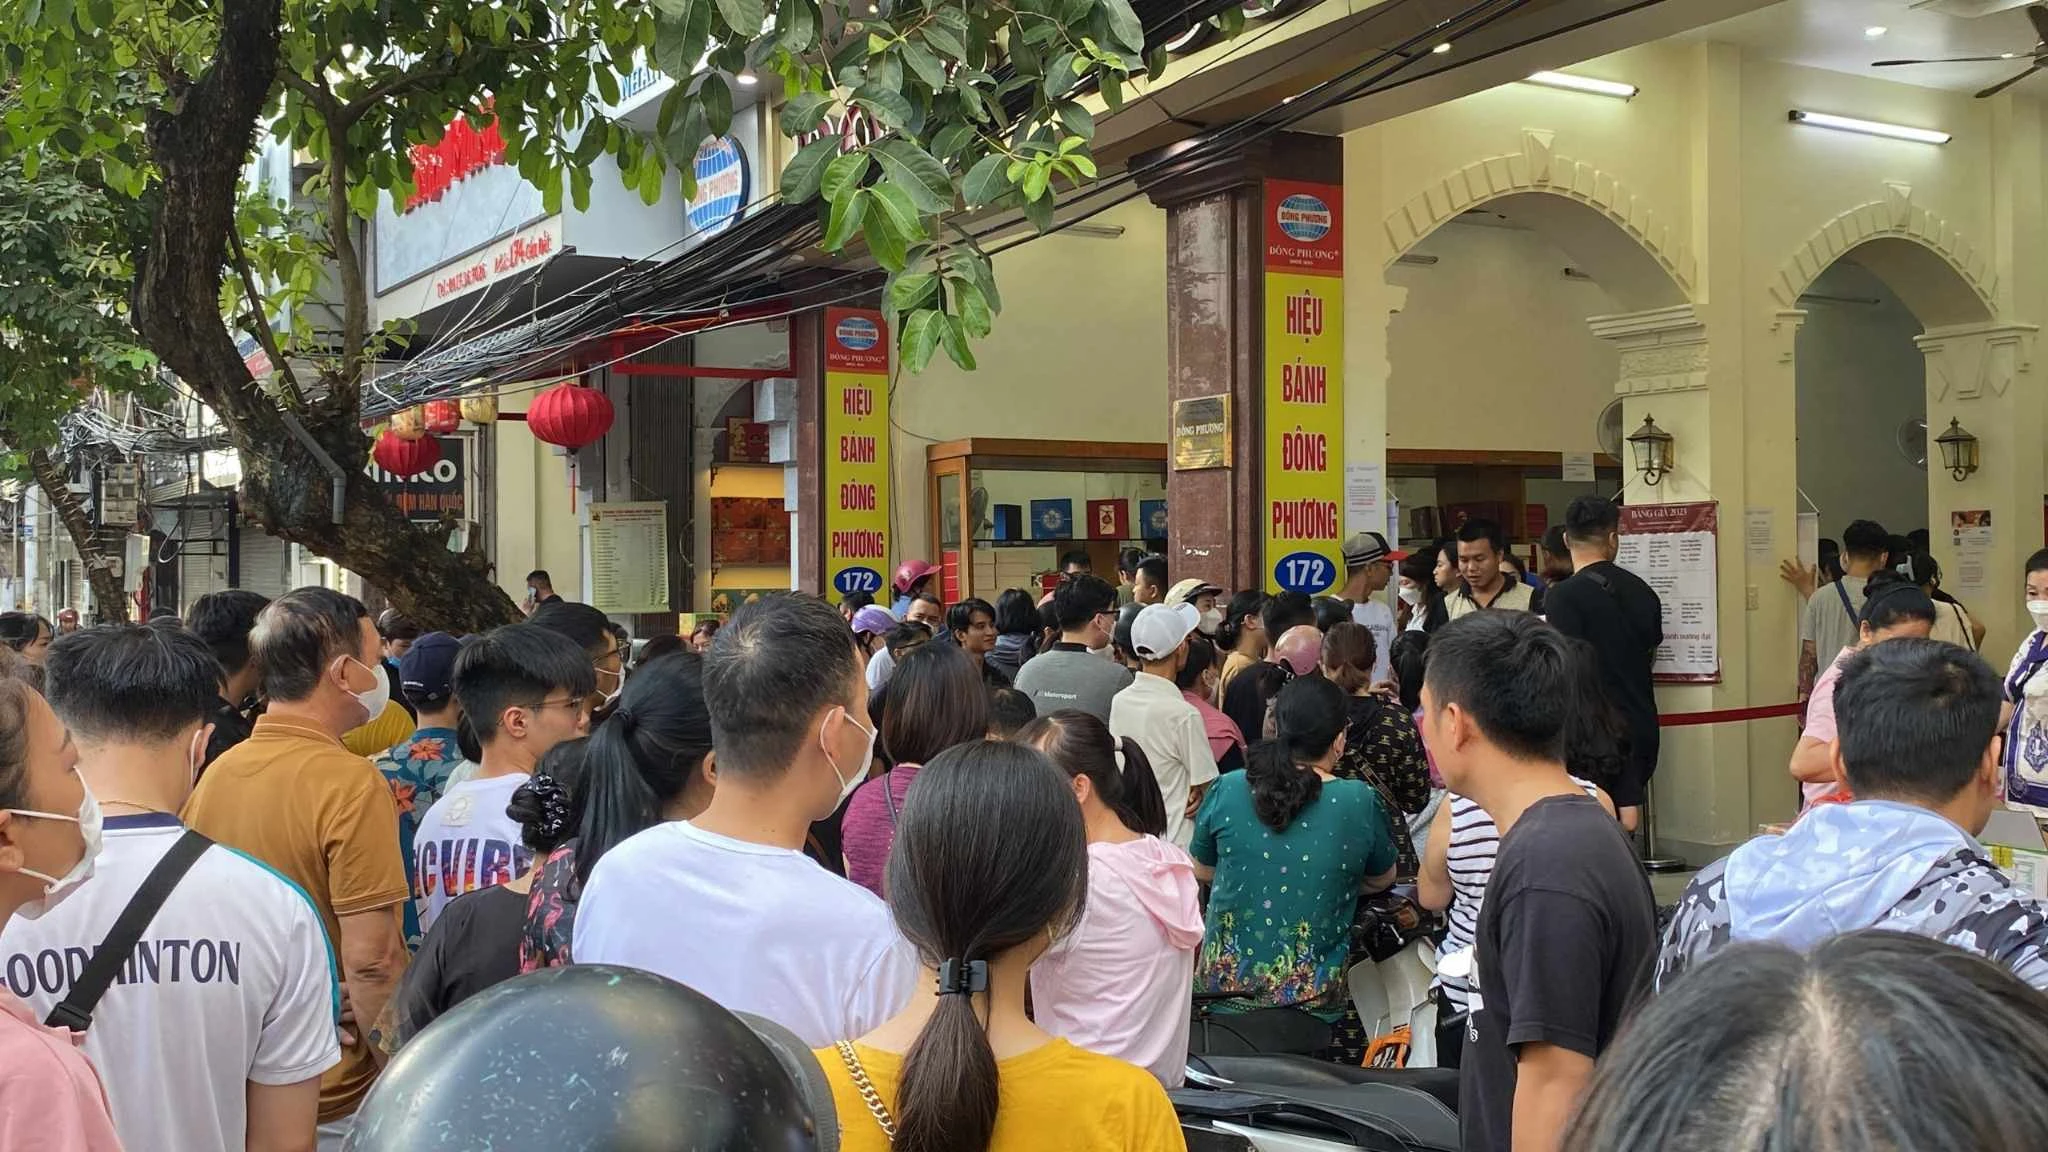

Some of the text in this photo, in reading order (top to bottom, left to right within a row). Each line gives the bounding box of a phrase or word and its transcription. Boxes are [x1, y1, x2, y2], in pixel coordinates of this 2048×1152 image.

[1286, 288, 1323, 344] HIỆU
[1282, 356, 1327, 404] BÁNH
[843, 382, 873, 422] HIỆU
[840, 430, 876, 463] BÁNH
[1282, 425, 1327, 472] ĐÔNG
[840, 478, 876, 511] ĐÔNG
[1272, 498, 1338, 540] PHƯƠNG
[832, 528, 884, 559] PHƯƠNG
[843, 571, 874, 592] 172
[1286, 559, 1325, 587] 172
[0, 938, 241, 999] OODINTON
